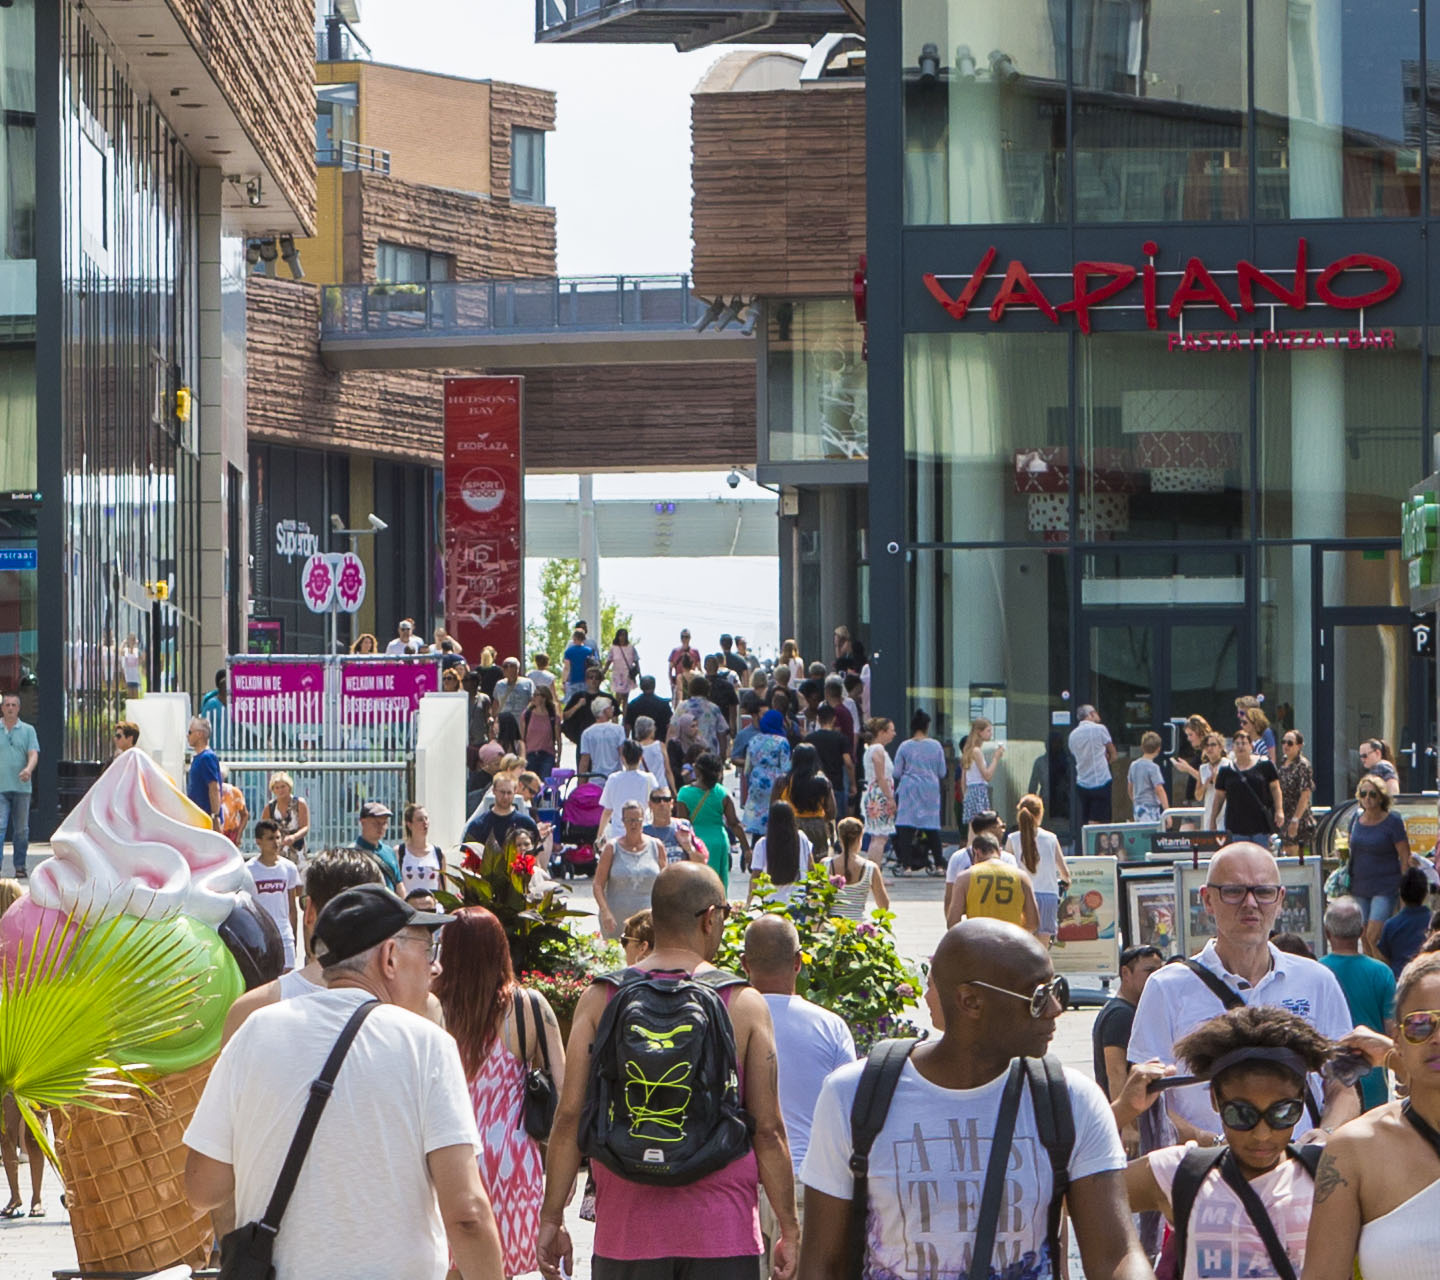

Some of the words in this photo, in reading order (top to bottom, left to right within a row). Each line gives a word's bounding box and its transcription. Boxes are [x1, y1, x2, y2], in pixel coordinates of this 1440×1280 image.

[1167, 332, 1243, 353] PASTA
[1262, 329, 1327, 351] PIZZA
[1347, 327, 1395, 351] BAR
[448, 394, 517, 405] HUDSON'S
[468, 407, 495, 417] BAY
[457, 440, 510, 452] EKOPLAZA
[465, 479, 502, 491] SPORT
[467, 489, 501, 499] 2000
[235, 676, 262, 691] WELKOM
[263, 676, 271, 691] IN
[272, 675, 282, 691] DE
[345, 676, 375, 691] WELKOM
[376, 675, 385, 690] IN
[386, 675, 395, 690] DE
[977, 874, 1014, 905] 75
